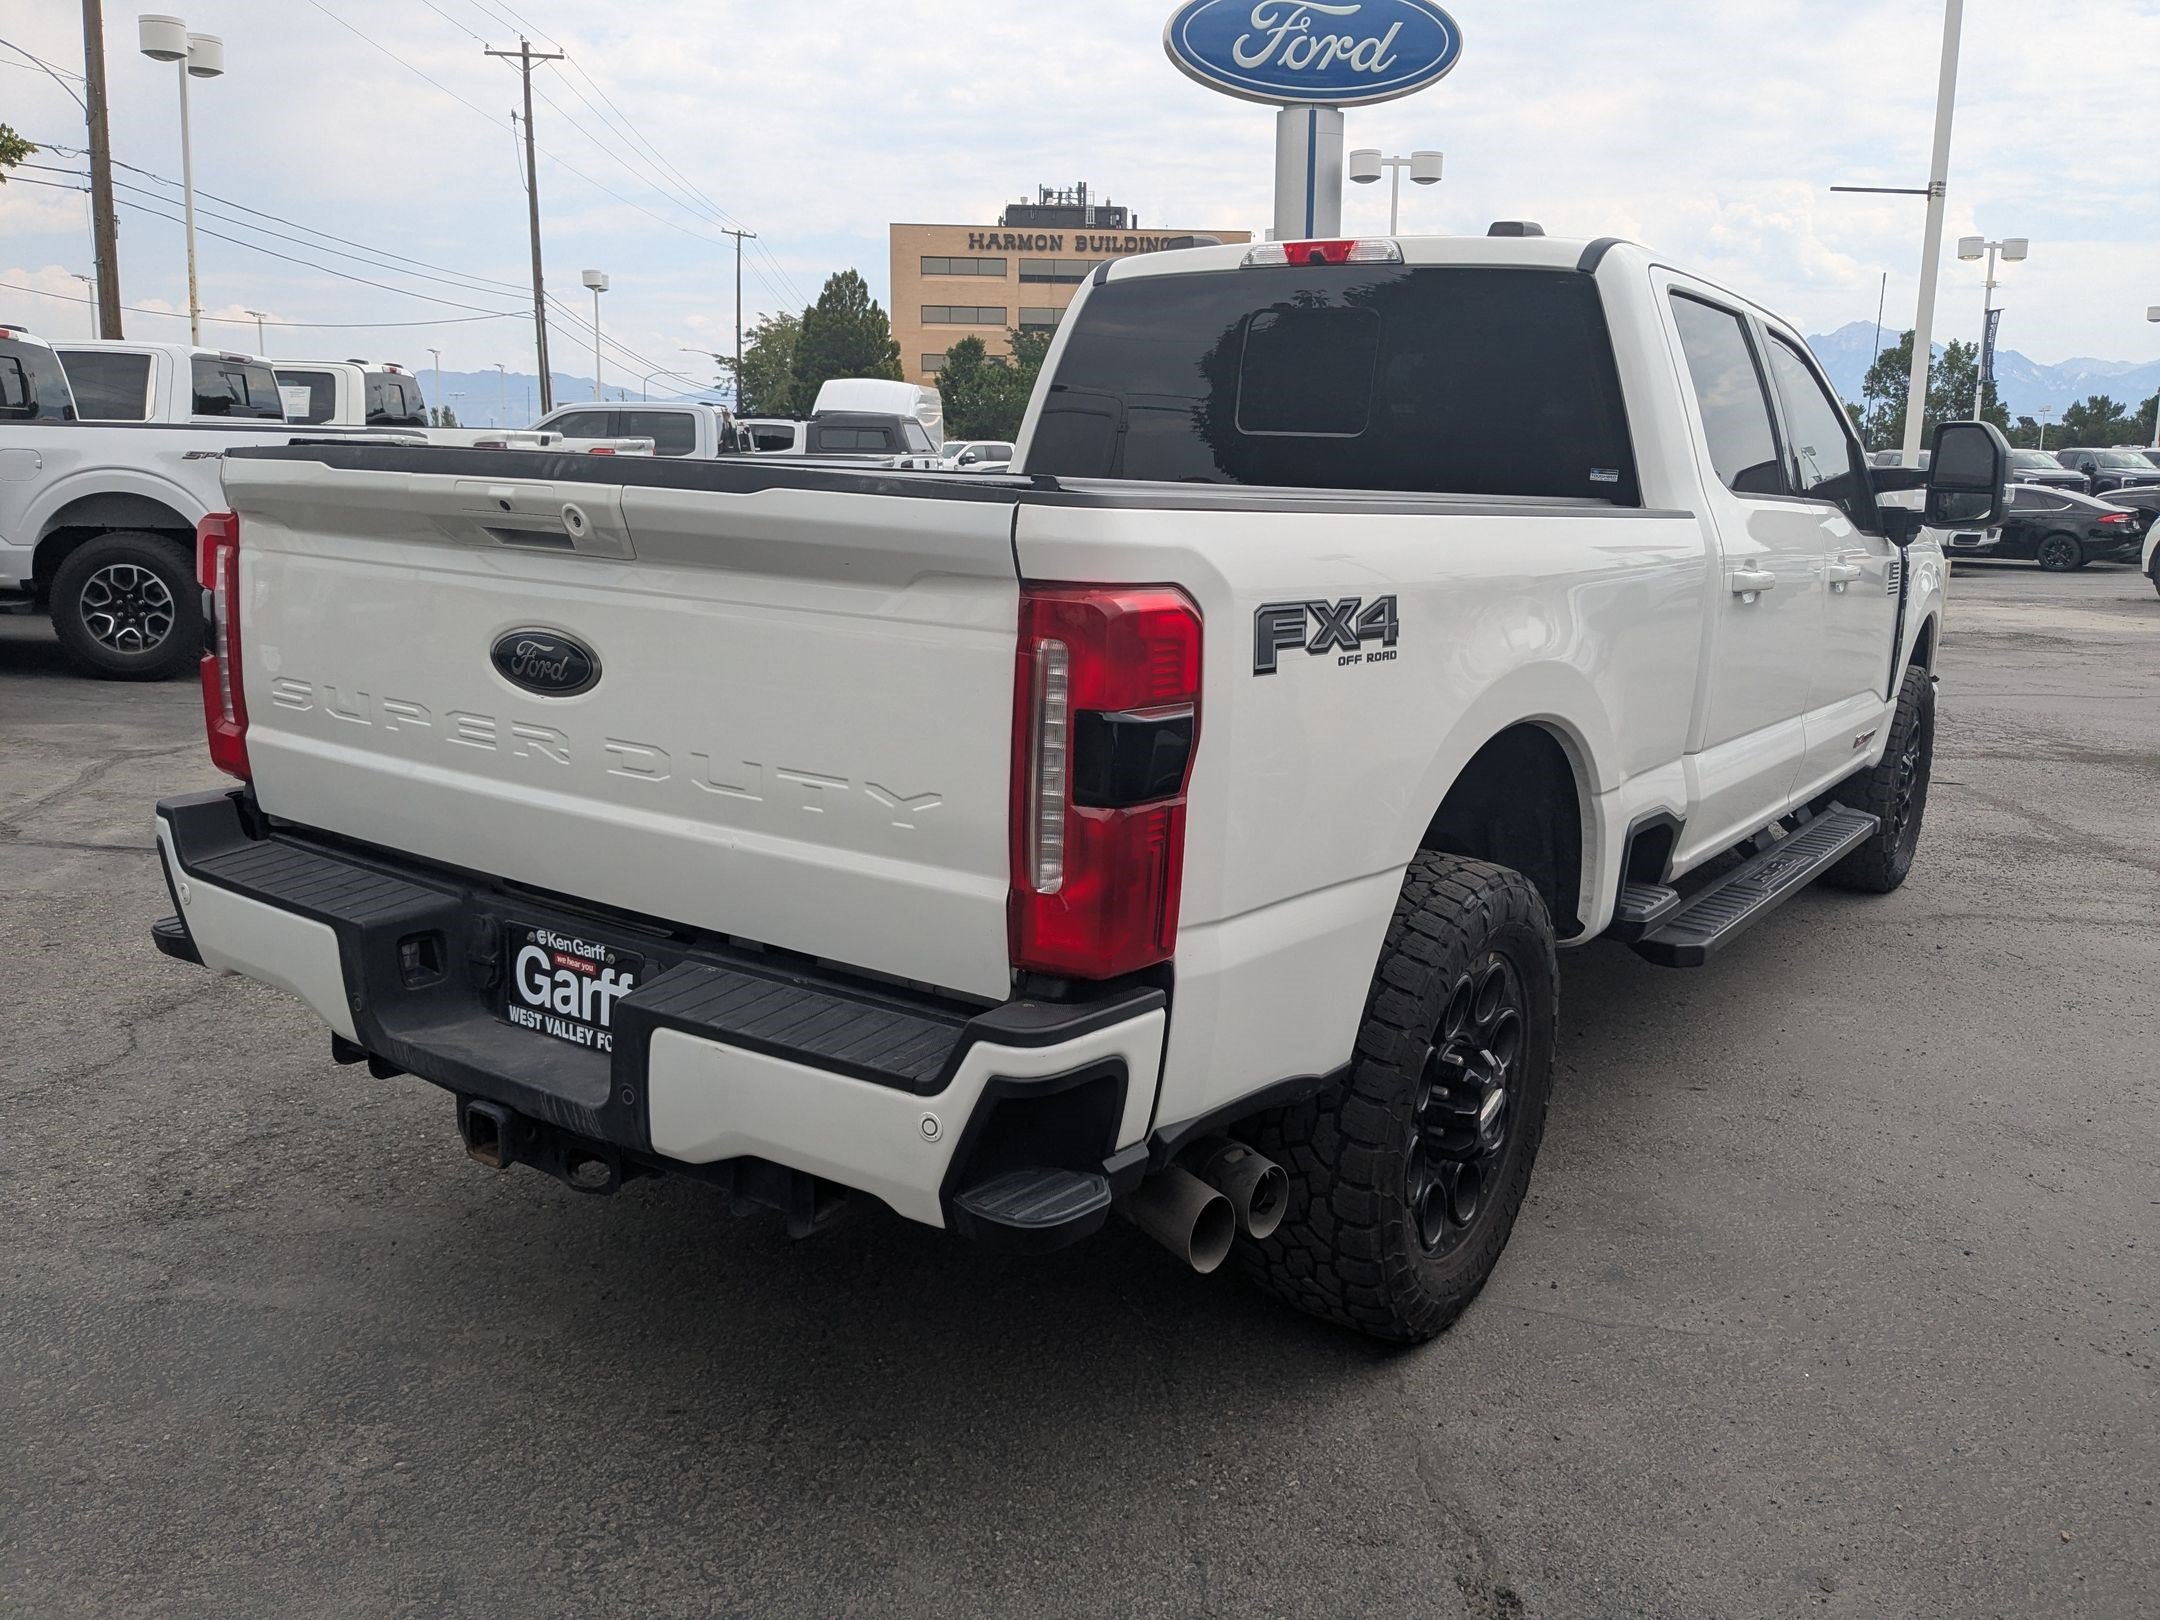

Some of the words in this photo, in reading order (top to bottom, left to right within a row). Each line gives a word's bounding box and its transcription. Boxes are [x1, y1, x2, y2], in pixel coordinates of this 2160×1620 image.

[1232, 0, 1404, 73] Ford
[968, 232, 1064, 251] HARMON
[1253, 594, 1399, 677] FX4
[511, 640, 569, 681] Ford
[1338, 655, 1362, 666] OFF
[1366, 650, 1397, 662] ROAD
[272, 677, 571, 765] SUPER
[605, 737, 943, 830] DUTY
[581, 963, 594, 972] you
[509, 1005, 542, 1030] WEST
[545, 1016, 594, 1046] VALLEY
